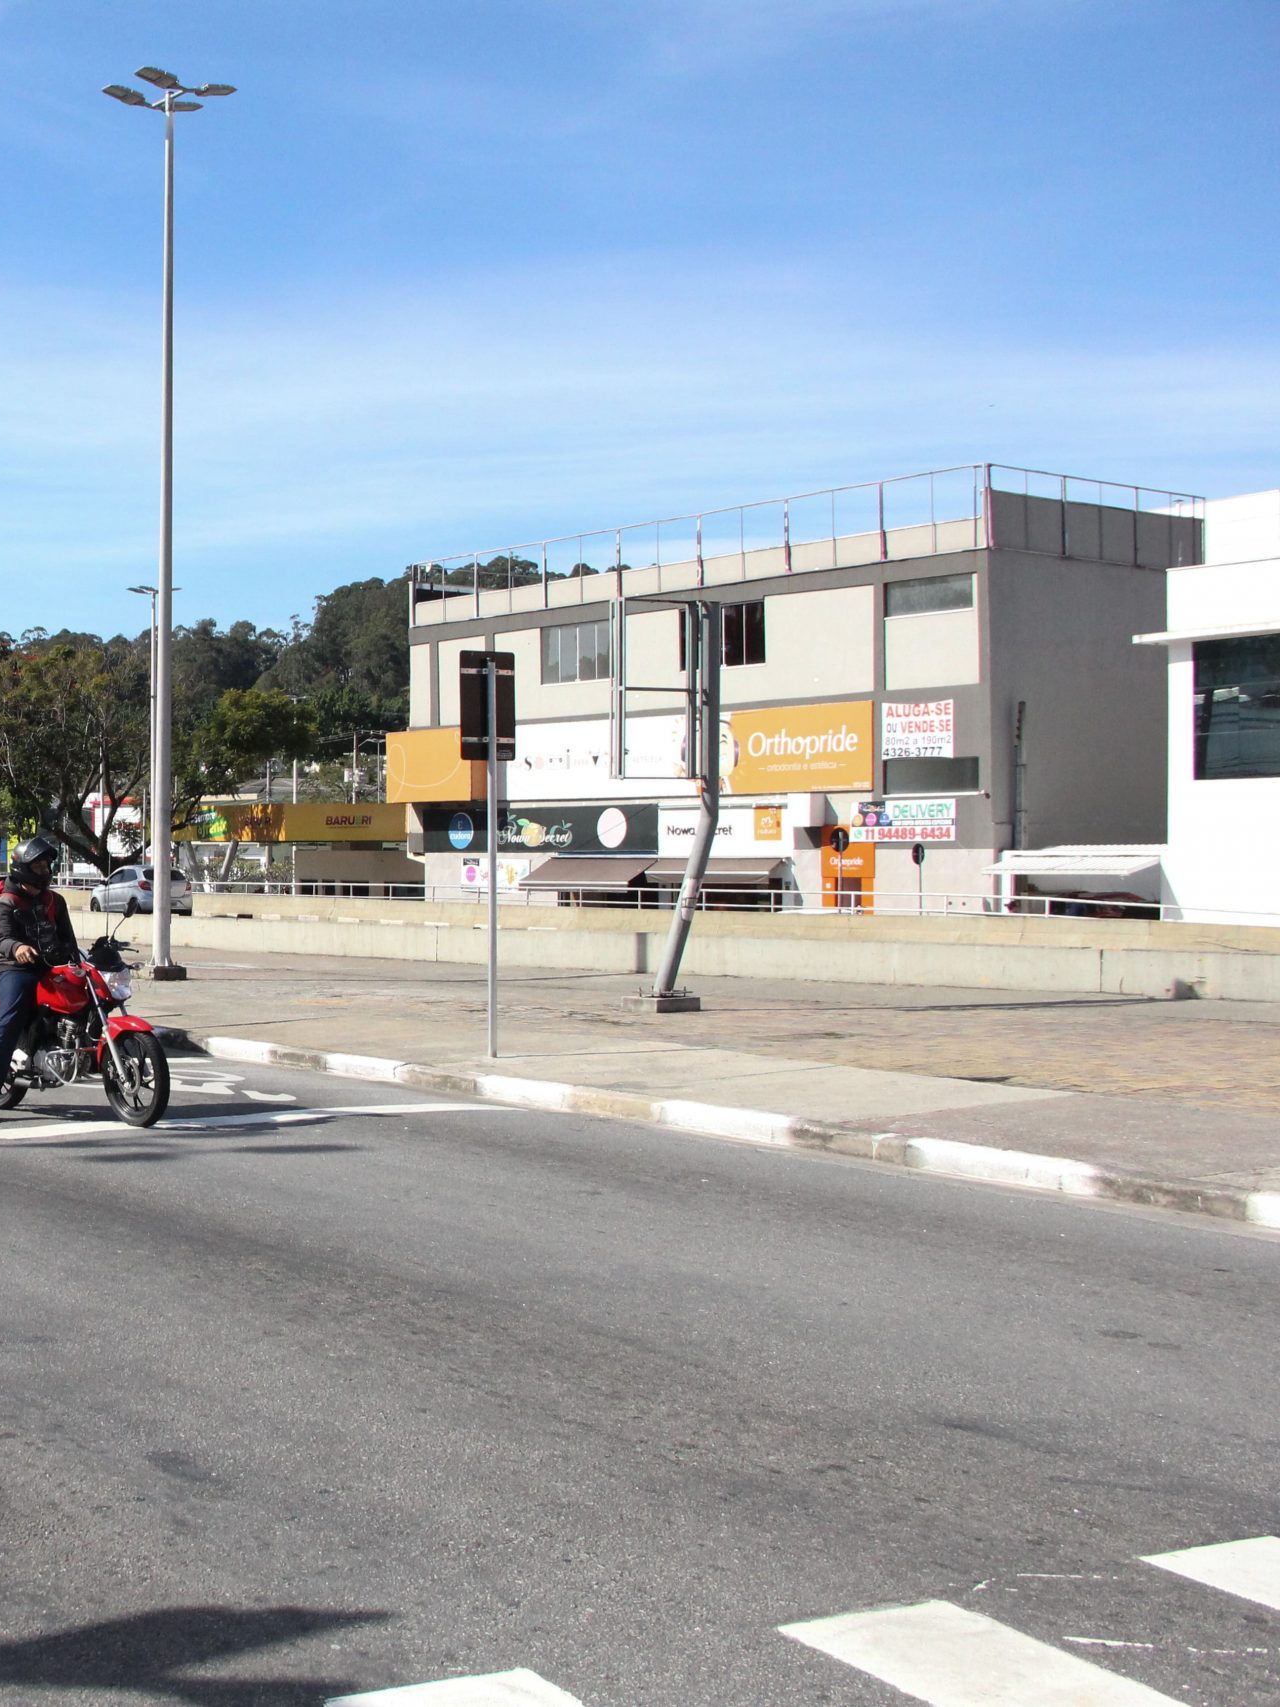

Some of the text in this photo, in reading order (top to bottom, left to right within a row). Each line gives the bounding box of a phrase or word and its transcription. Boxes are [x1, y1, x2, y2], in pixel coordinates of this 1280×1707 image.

[886, 703, 951, 718] ALUGA-SE
[886, 719, 951, 734] OU VENDE-SE
[748, 725, 858, 760] Orthopride
[921, 735, 952, 745] 190m2
[882, 746, 943, 757] 4326-3777
[892, 803, 953, 819] DELIVERY
[667, 825, 696, 836] Nowa
[864, 827, 951, 840] 11 94489-6434
